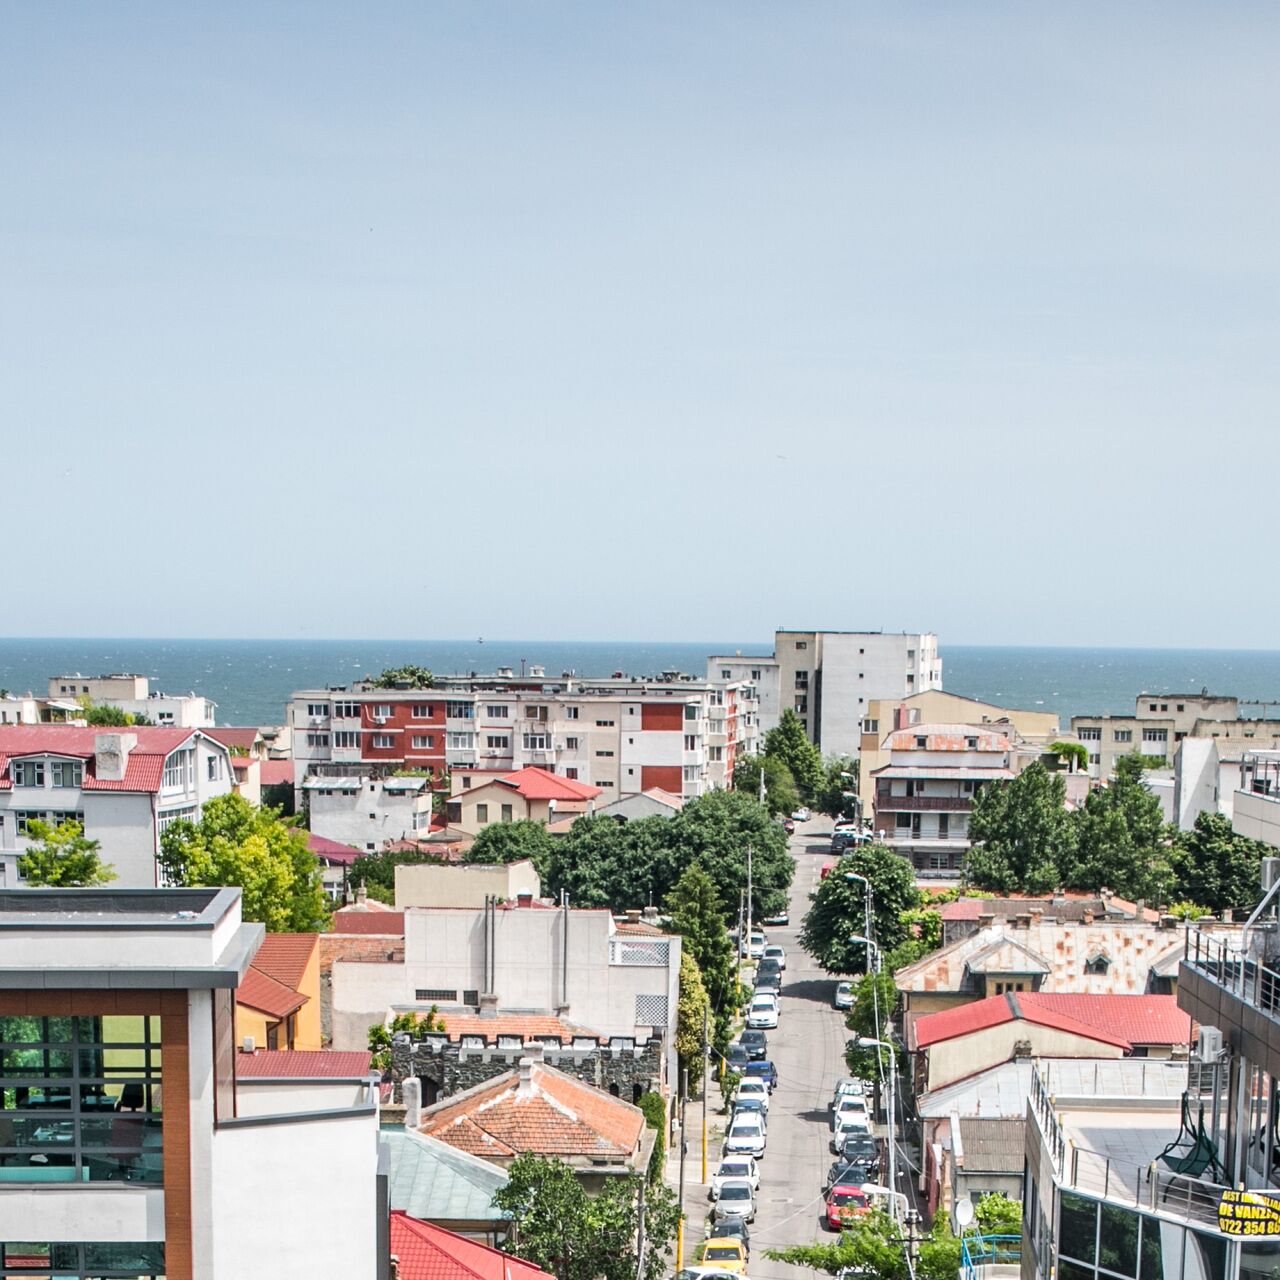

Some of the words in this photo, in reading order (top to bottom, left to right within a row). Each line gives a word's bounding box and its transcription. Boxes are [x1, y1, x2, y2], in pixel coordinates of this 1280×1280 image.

[1219, 1202, 1233, 1216] DE
[1220, 1218, 1242, 1234] 0722
[1244, 1221, 1265, 1234] 354
